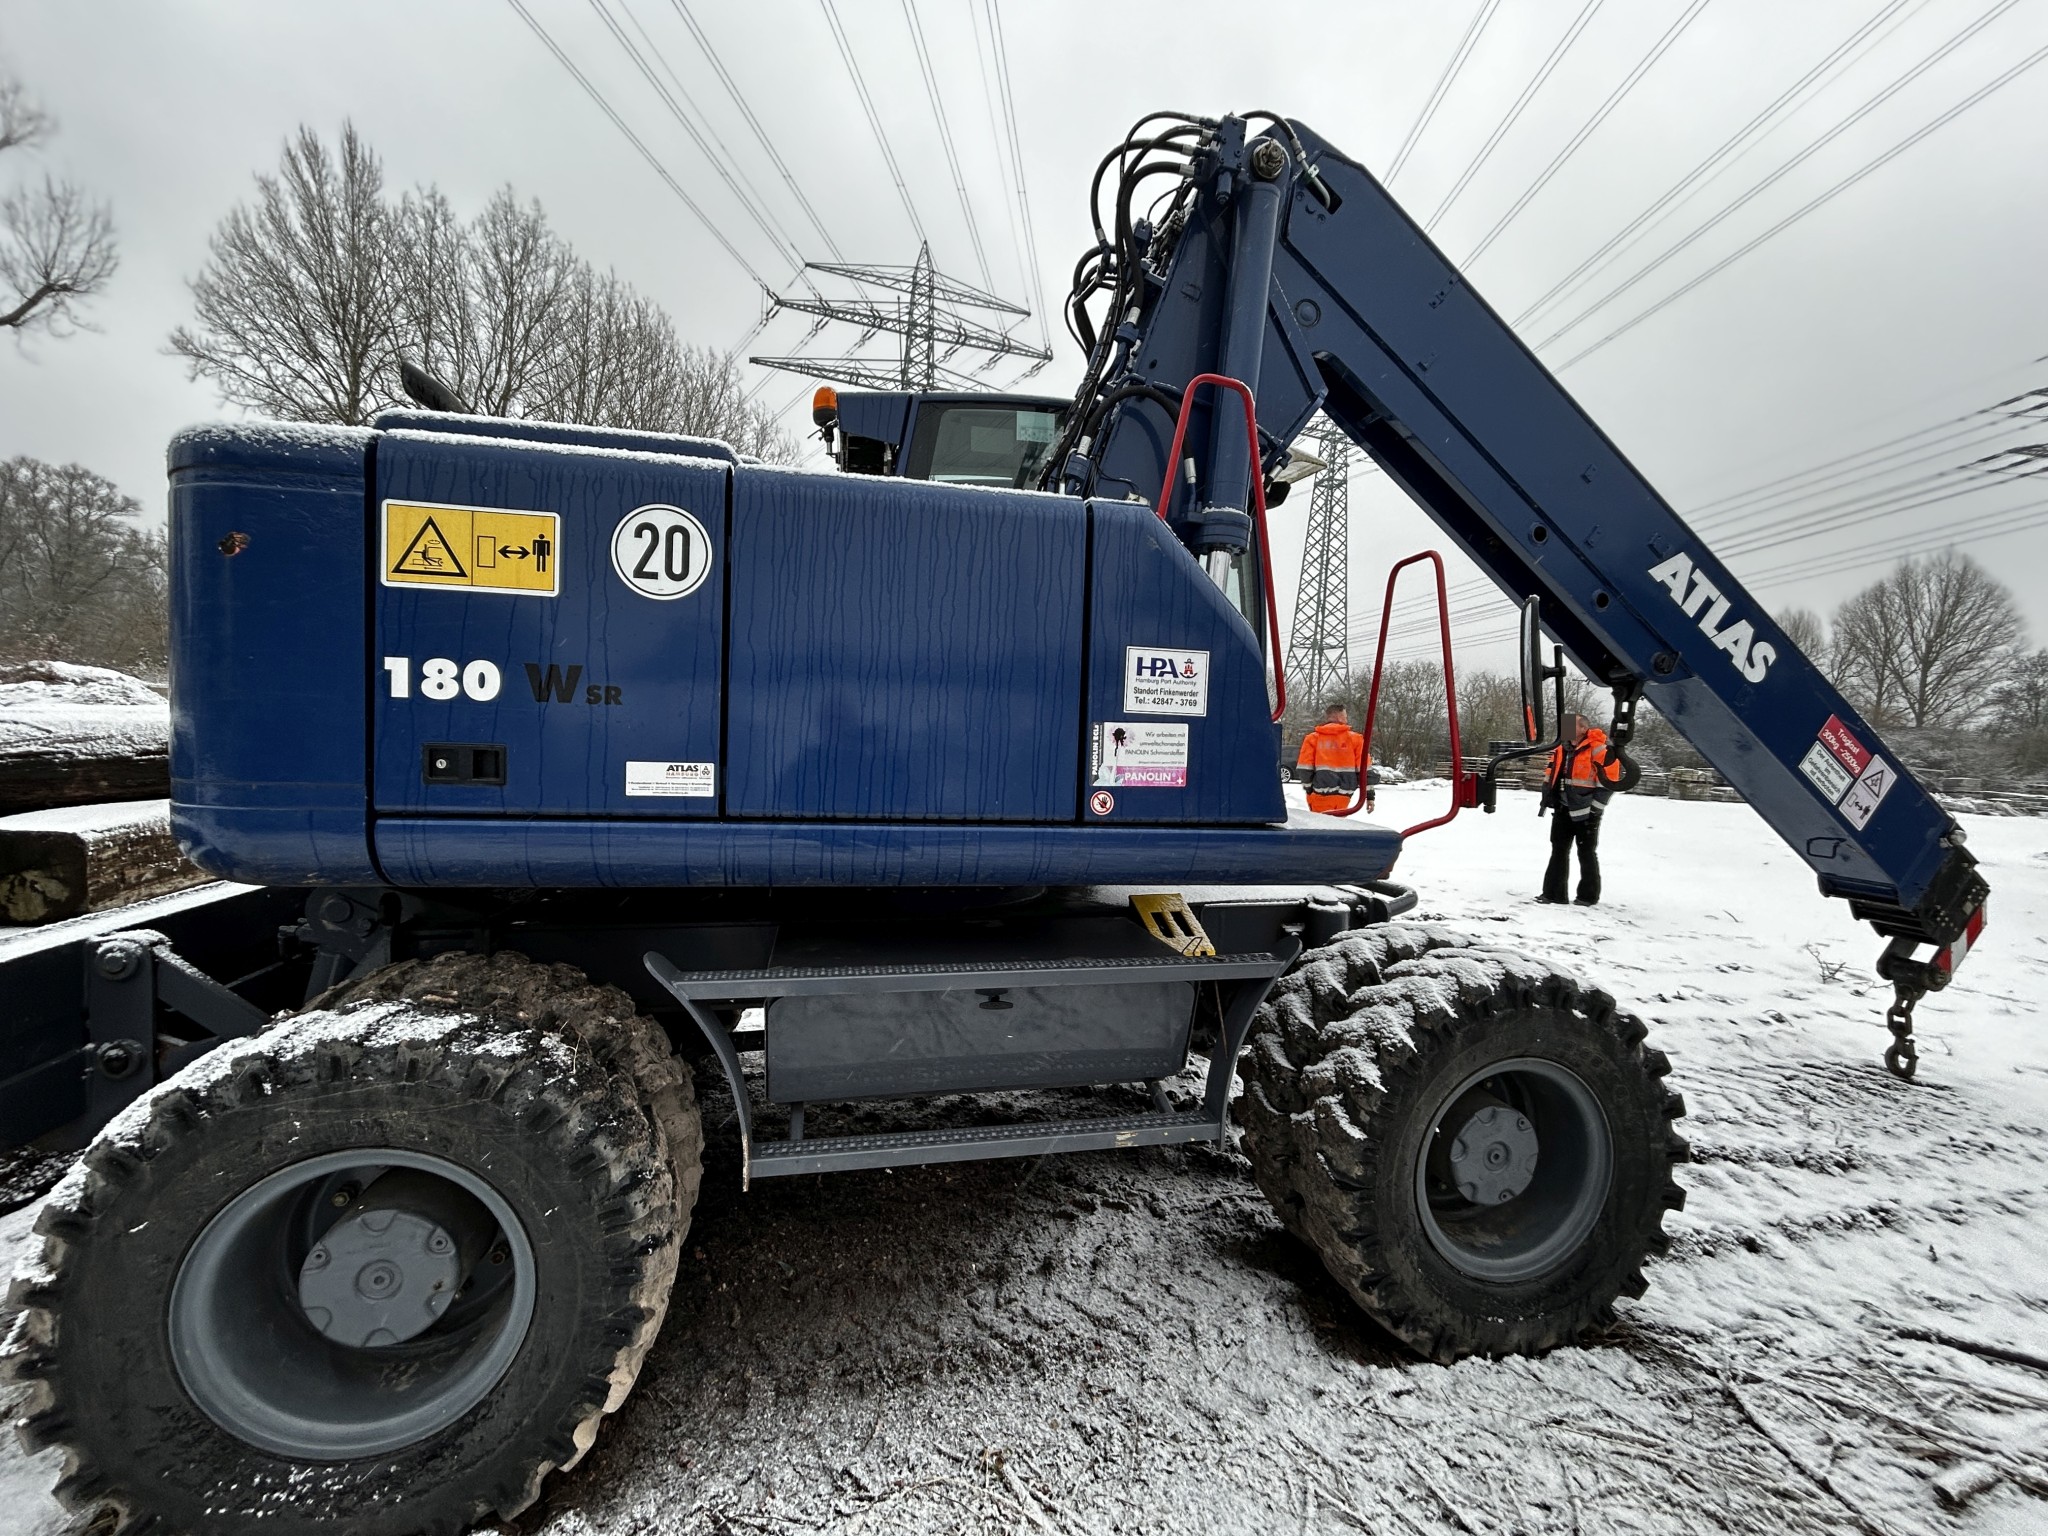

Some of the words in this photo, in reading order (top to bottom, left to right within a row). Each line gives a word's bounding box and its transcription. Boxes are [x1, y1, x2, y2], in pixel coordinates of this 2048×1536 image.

[632, 521, 691, 582] 20
[1647, 551, 1777, 683] ATLAS
[1136, 656, 1179, 678] HPA
[383, 656, 501, 702] 180
[1135, 677, 1160, 685] Hamburg
[1172, 679, 1197, 687] Authority
[1133, 686, 1159, 696] Standort
[1159, 687, 1199, 697] Finkenwerder
[1134, 696, 1150, 704] Tel.:
[1151, 697, 1174, 705] 42847
[1179, 698, 1198, 707] 3769
[1837, 728, 1860, 755] Traglast
[666, 764, 699, 772] ATLAS
[1124, 772, 1172, 781] PANOLIN
